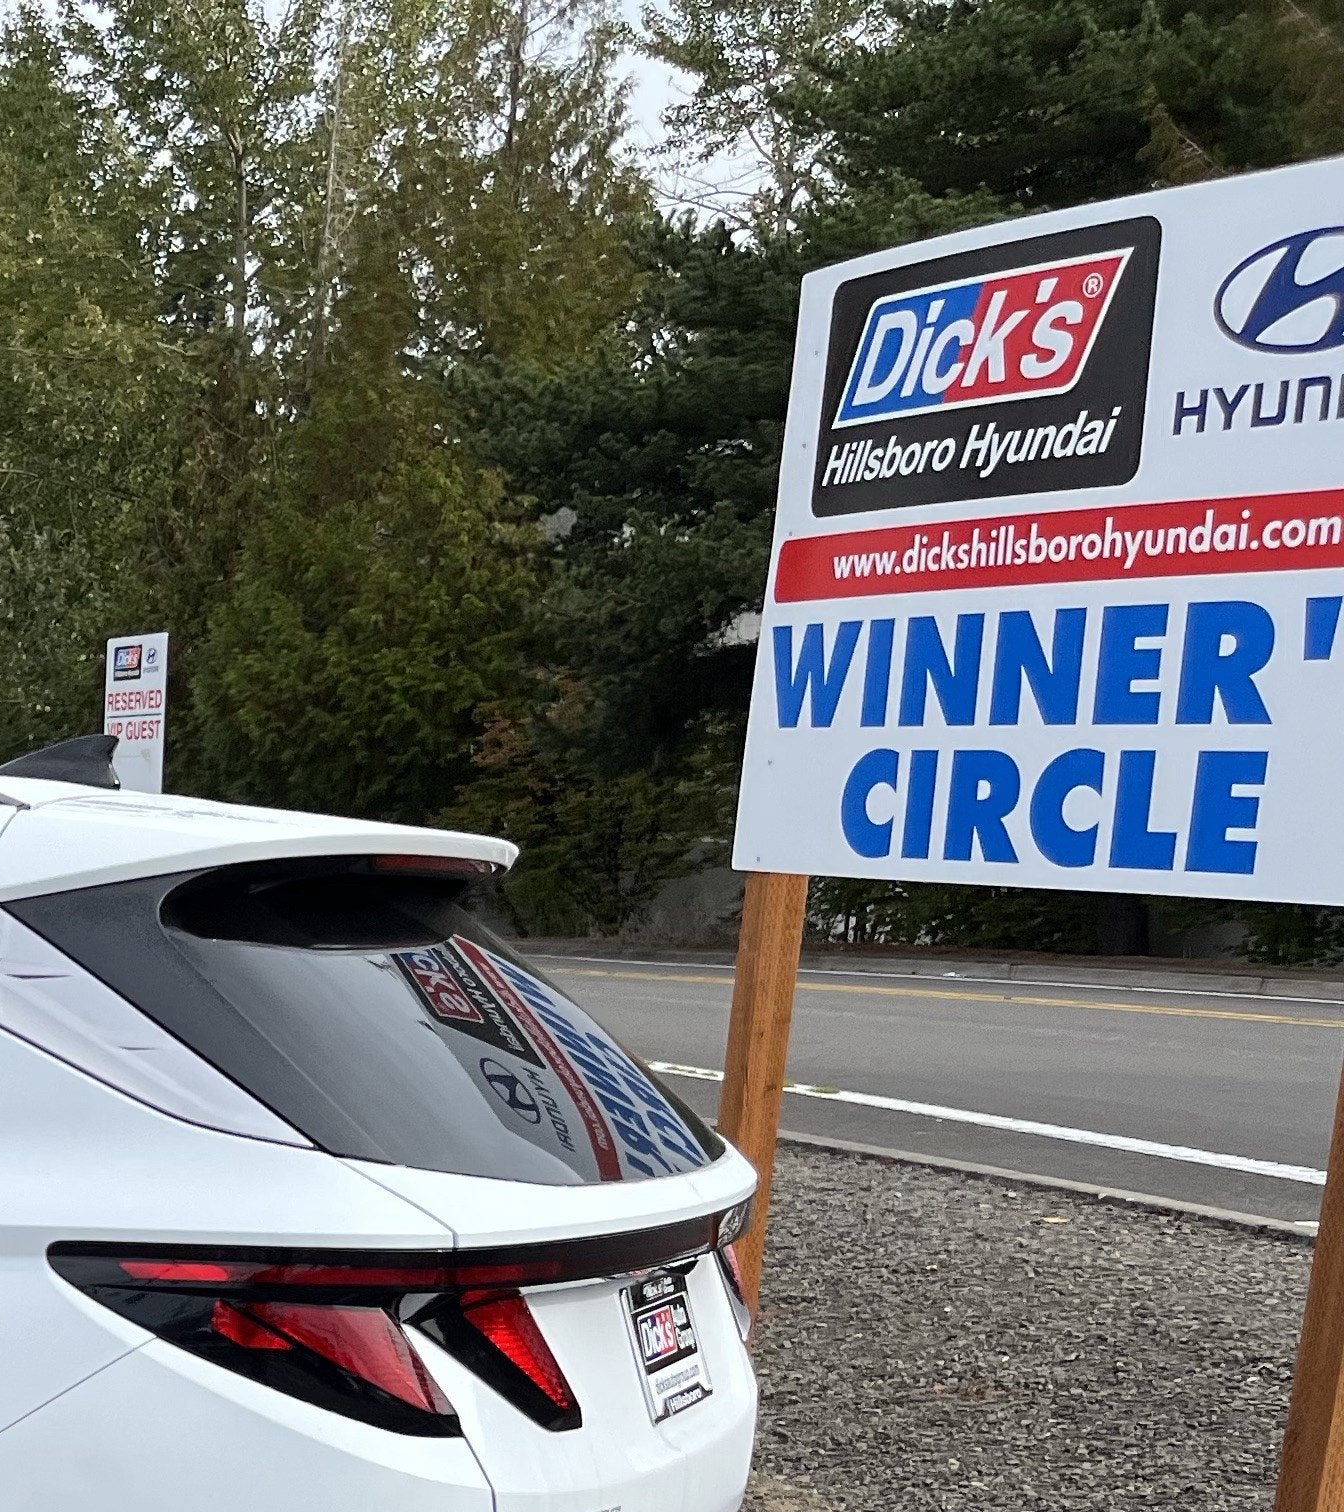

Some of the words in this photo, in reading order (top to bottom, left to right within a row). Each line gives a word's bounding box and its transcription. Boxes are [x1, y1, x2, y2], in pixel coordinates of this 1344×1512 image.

[851, 277, 1084, 407] Dick's
[1172, 373, 1344, 436] HYUN
[821, 435, 957, 487] Hillsboro
[959, 405, 1123, 478] Hyundai
[832, 508, 1343, 580] www.dickshillsborohyundai.com
[107, 689, 162, 711] RESERVED
[125, 720, 161, 740] GUEST
[840, 747, 1270, 876] CIRCLE
[640, 1313, 675, 1358] Dick's
